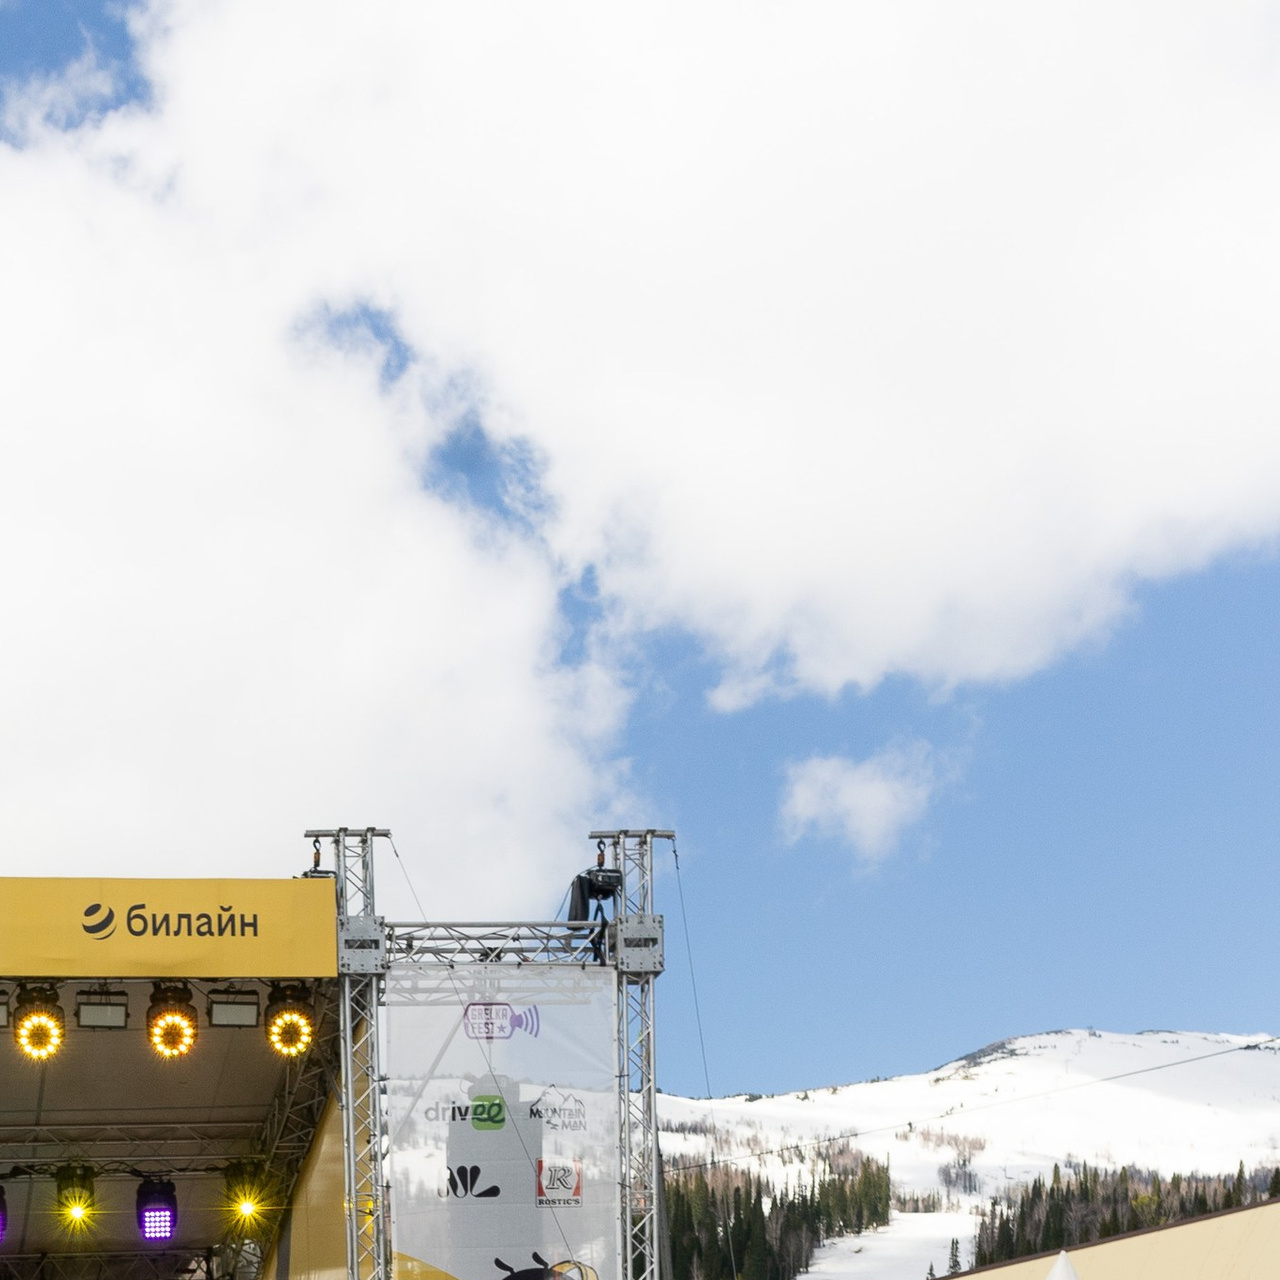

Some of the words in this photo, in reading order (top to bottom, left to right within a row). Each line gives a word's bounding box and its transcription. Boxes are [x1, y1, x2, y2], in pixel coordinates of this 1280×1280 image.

[126, 903, 259, 937] билайн
[471, 1007, 508, 1021] GRELKA
[472, 1021, 495, 1035] FEST
[424, 1100, 506, 1124] drivee
[529, 1107, 586, 1120] MOUNTAIN
[561, 1120, 588, 1131] MAN
[538, 1198, 581, 1206] ROSTIC'S
